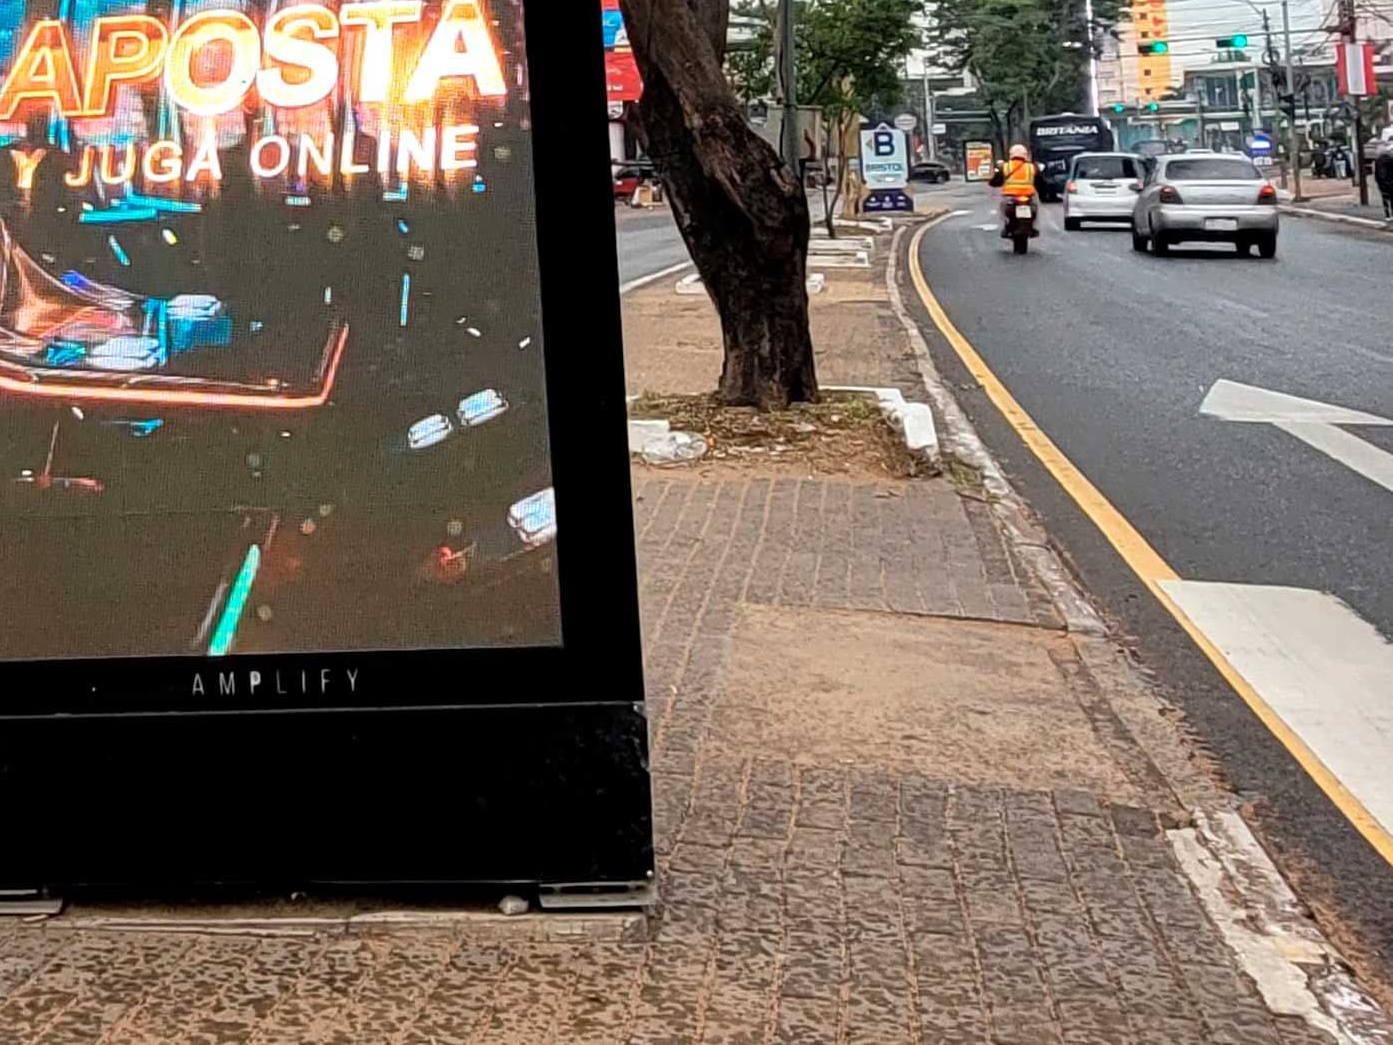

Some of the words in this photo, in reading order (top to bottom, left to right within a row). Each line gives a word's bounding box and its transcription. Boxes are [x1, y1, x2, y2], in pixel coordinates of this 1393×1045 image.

[10, 148, 45, 190] Y
[250, 125, 479, 179] ONLINE
[873, 131, 895, 157] B
[192, 668, 359, 696] AMPLIFY
